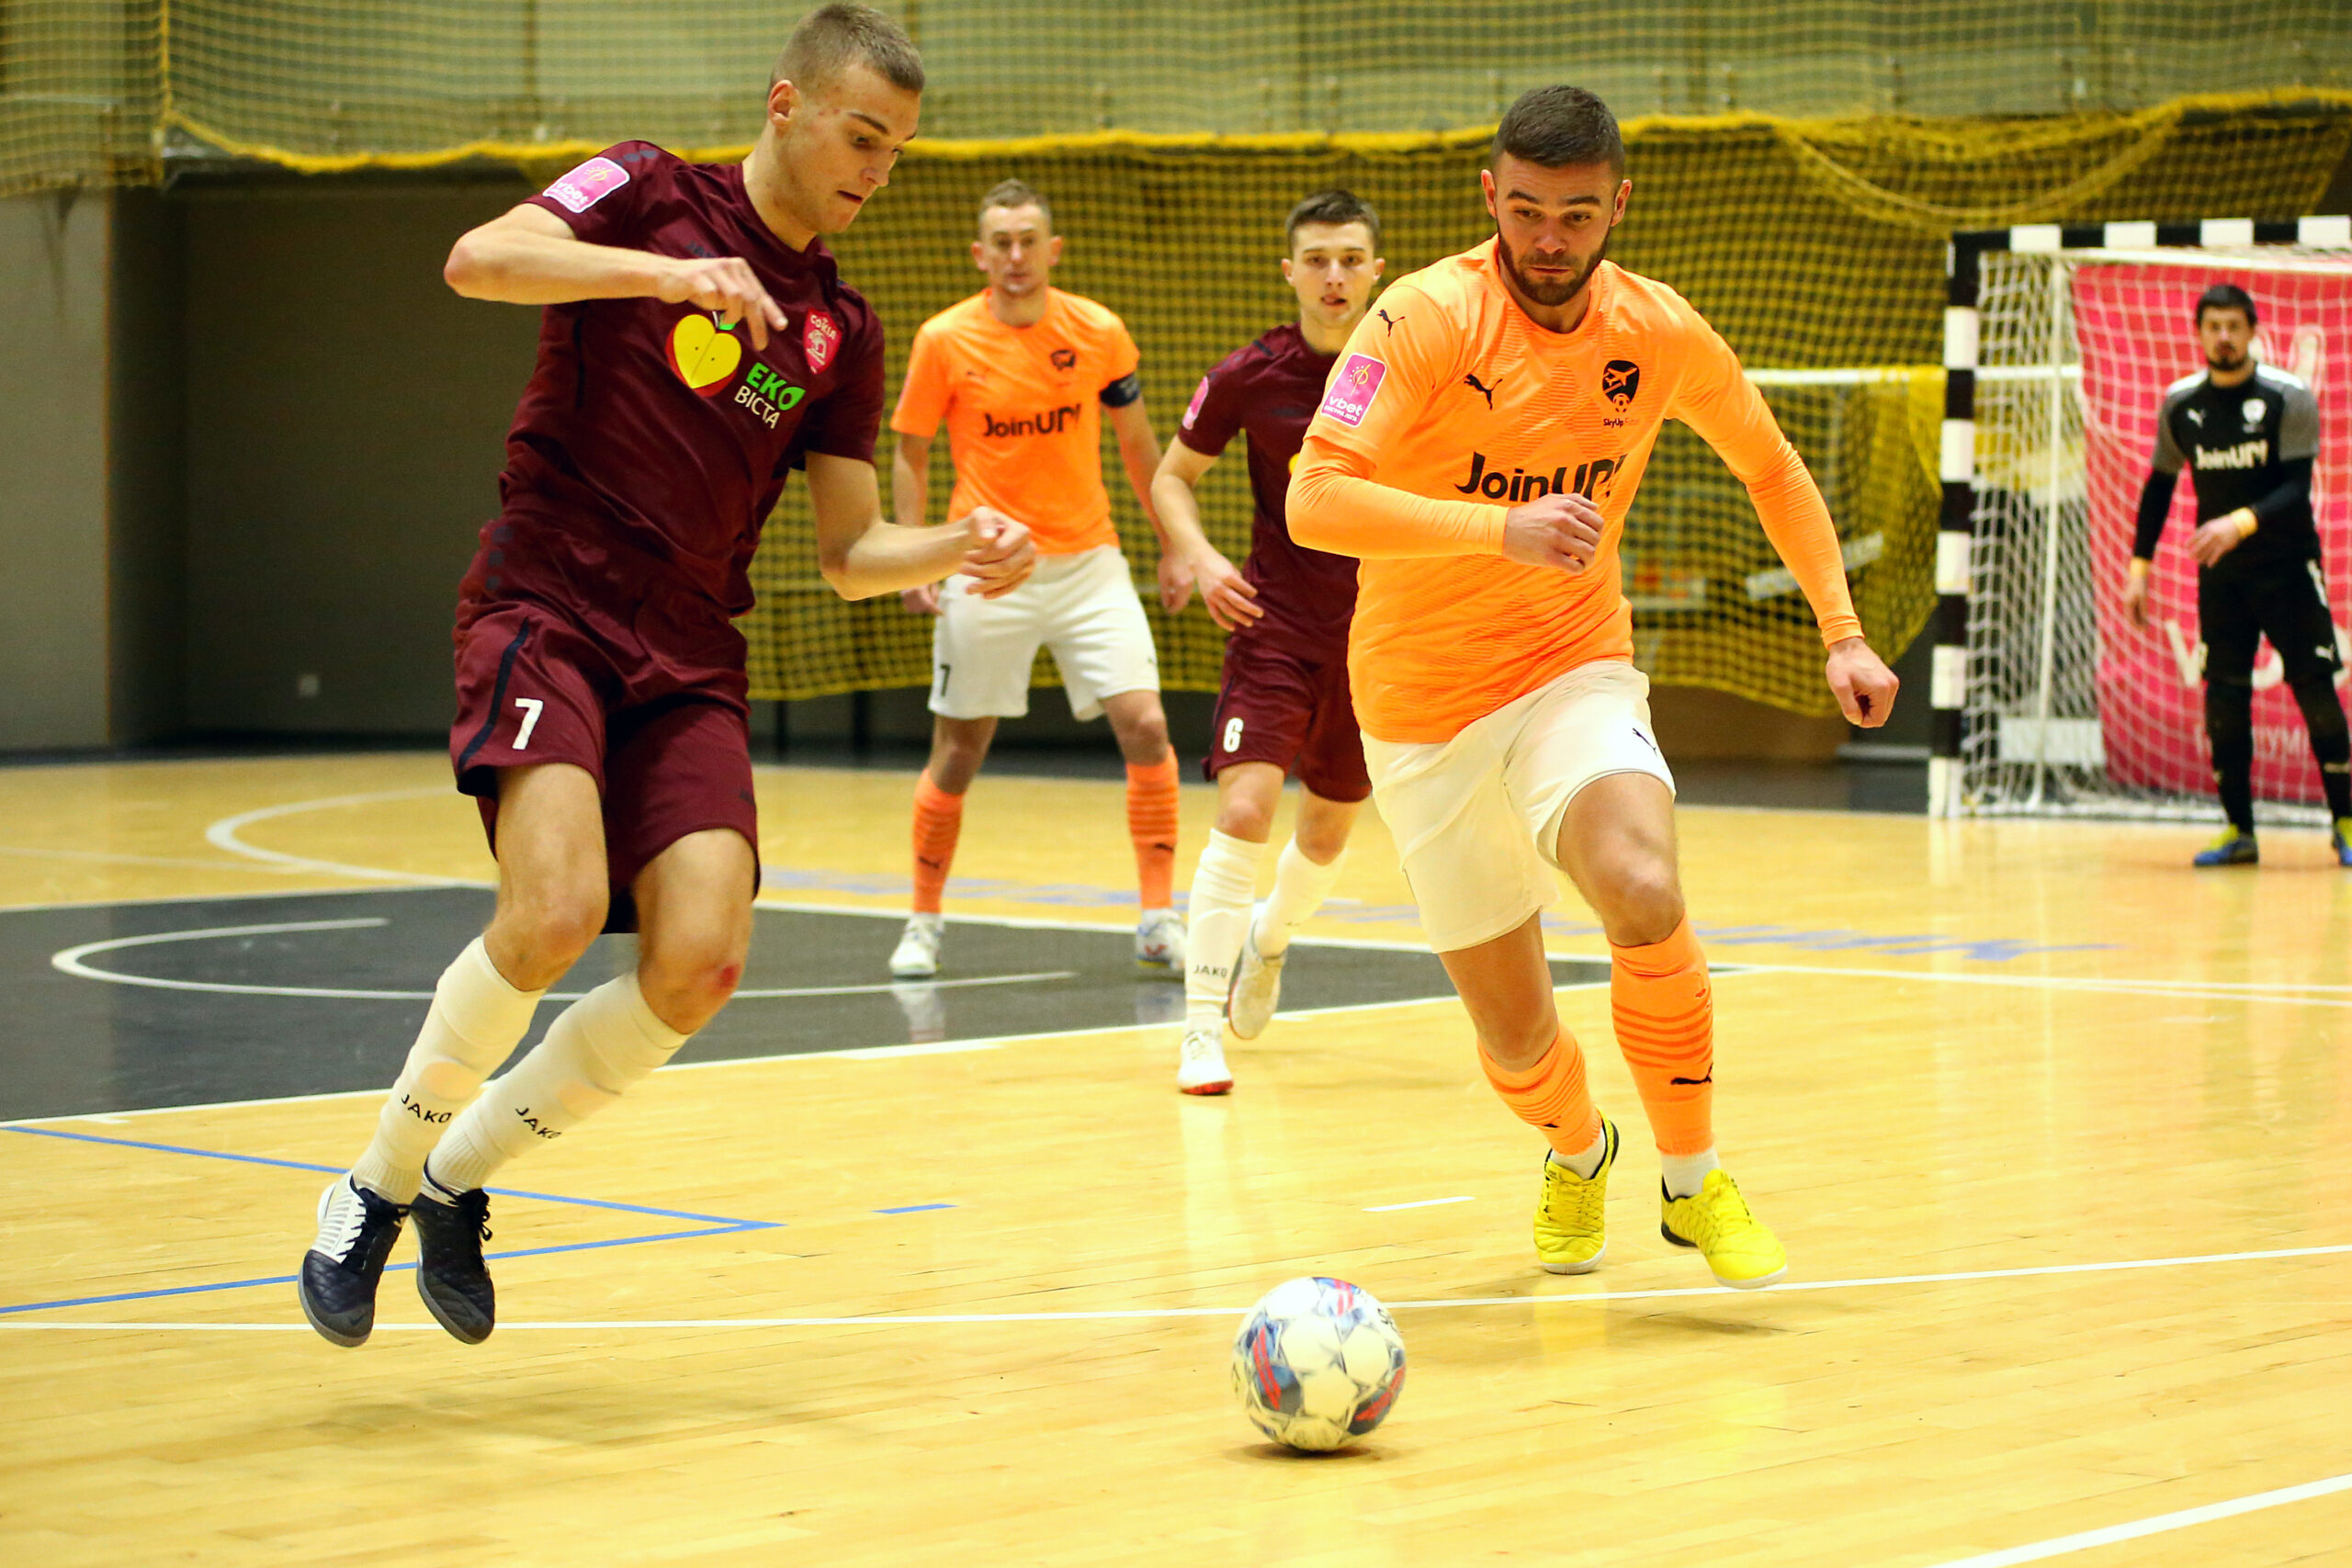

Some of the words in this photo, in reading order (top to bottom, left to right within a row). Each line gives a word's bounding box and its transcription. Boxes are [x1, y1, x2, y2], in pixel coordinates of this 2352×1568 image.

[556, 182, 589, 205] vbet
[1329, 396, 1363, 417] vbet
[1603, 418, 1624, 429] SkyUp
[939, 662, 951, 697] 7
[512, 698, 544, 750] 7
[1223, 716, 1244, 753] 6
[1193, 964, 1228, 978] JAKO
[401, 1093, 452, 1123] JAKO
[514, 1107, 562, 1139] JAKO
